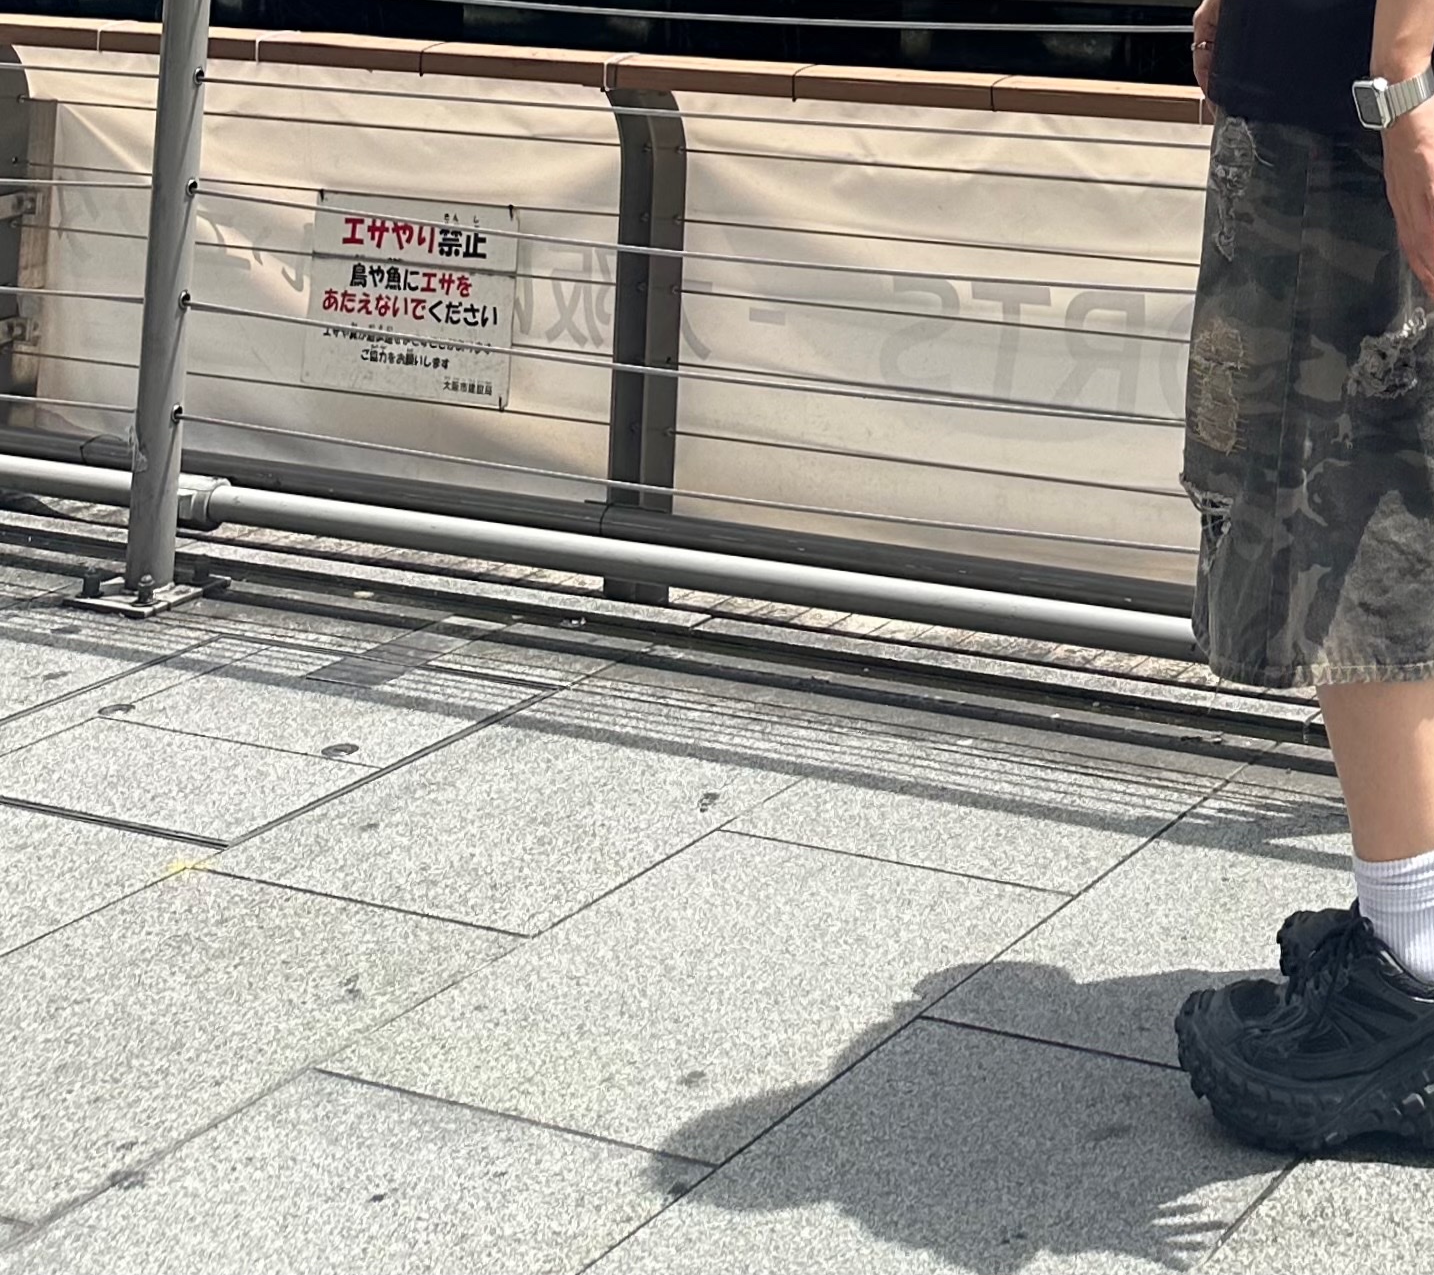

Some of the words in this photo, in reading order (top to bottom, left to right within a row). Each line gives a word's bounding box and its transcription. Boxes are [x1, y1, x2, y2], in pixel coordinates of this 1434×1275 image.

[342, 217, 487, 259] エサやり禁止
[350, 262, 472, 298] 鳥や魚にエサを
[322, 288, 498, 327] あたえないでください
[361, 347, 450, 370] ご協力をお願いします
